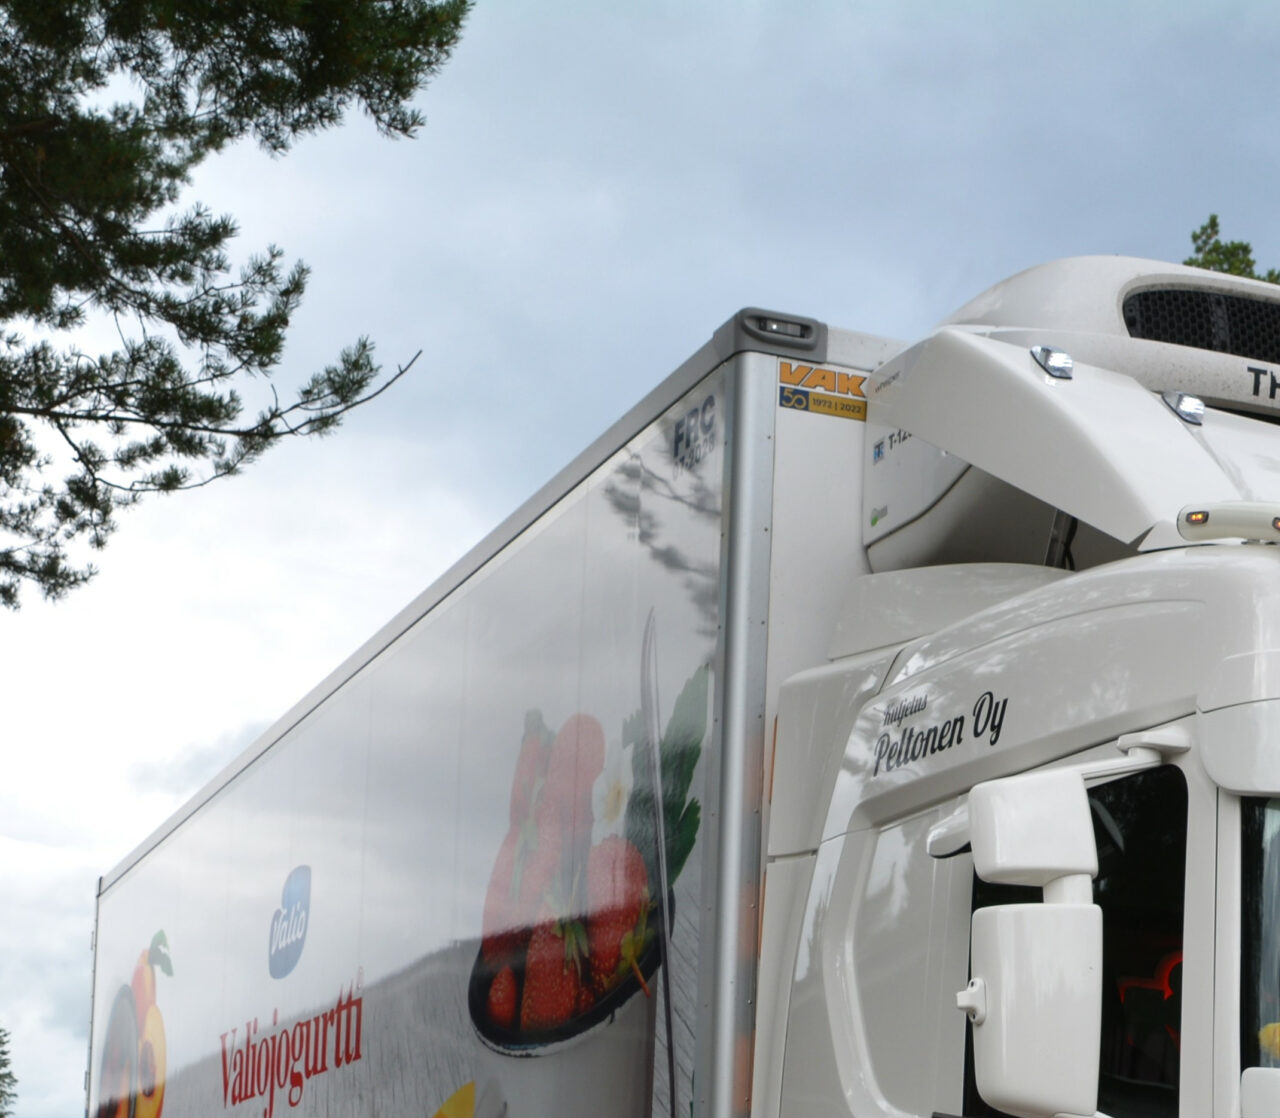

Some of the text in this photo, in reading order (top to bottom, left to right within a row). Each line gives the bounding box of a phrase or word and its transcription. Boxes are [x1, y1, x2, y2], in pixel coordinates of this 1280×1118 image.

[778, 361, 868, 399] VAK
[781, 387, 807, 409] 50
[674, 394, 715, 457] FRC
[873, 691, 1009, 777] Peltonen Oy
